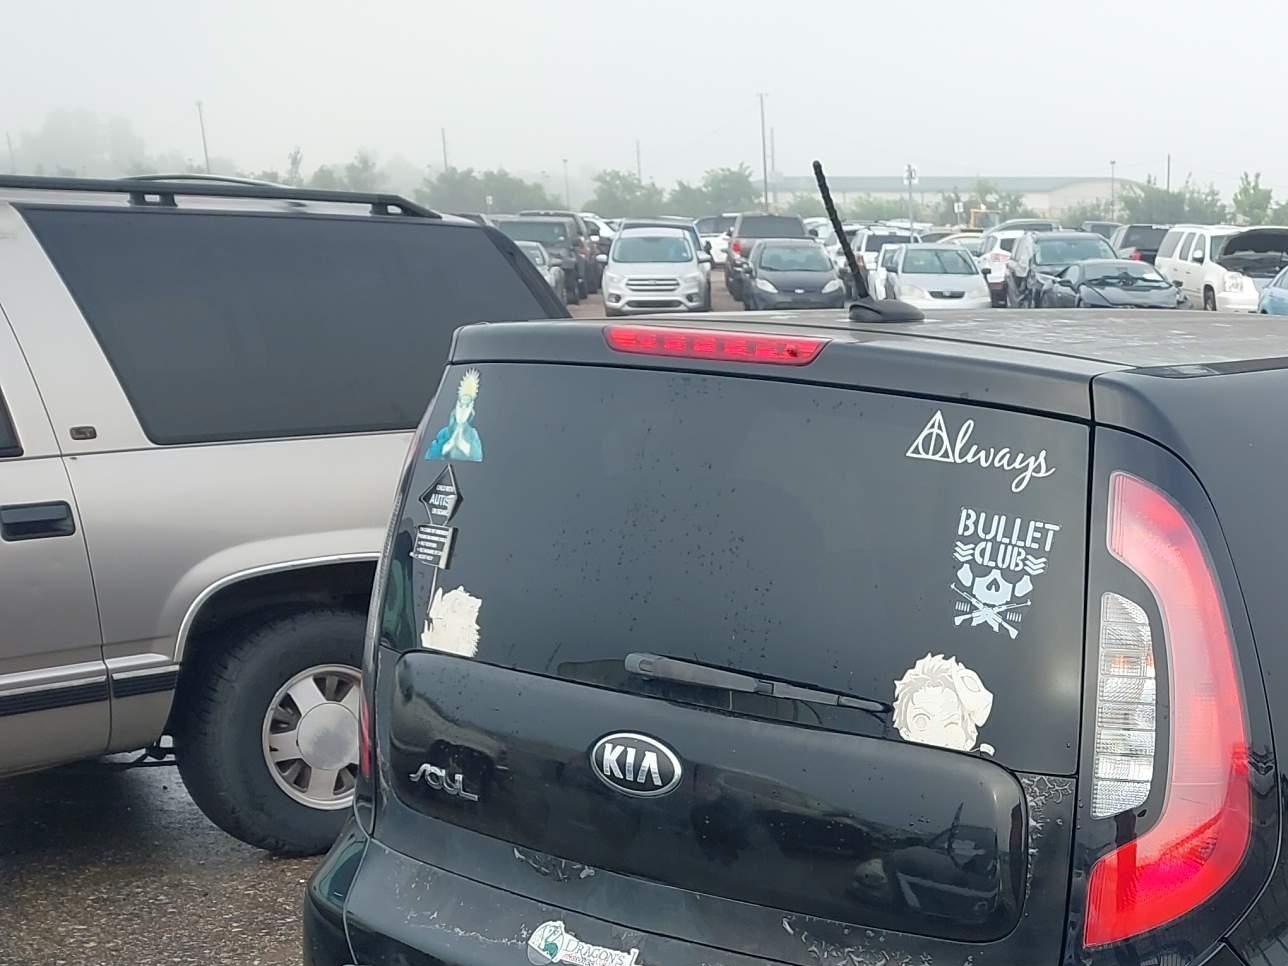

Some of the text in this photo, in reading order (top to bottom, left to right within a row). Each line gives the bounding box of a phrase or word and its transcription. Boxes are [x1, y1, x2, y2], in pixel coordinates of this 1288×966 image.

[906, 410, 1056, 492] Always
[429, 493, 449, 508] AUTIS
[958, 508, 1061, 552] BULLET
[974, 541, 1026, 571] CLUB
[603, 743, 662, 786] KIA
